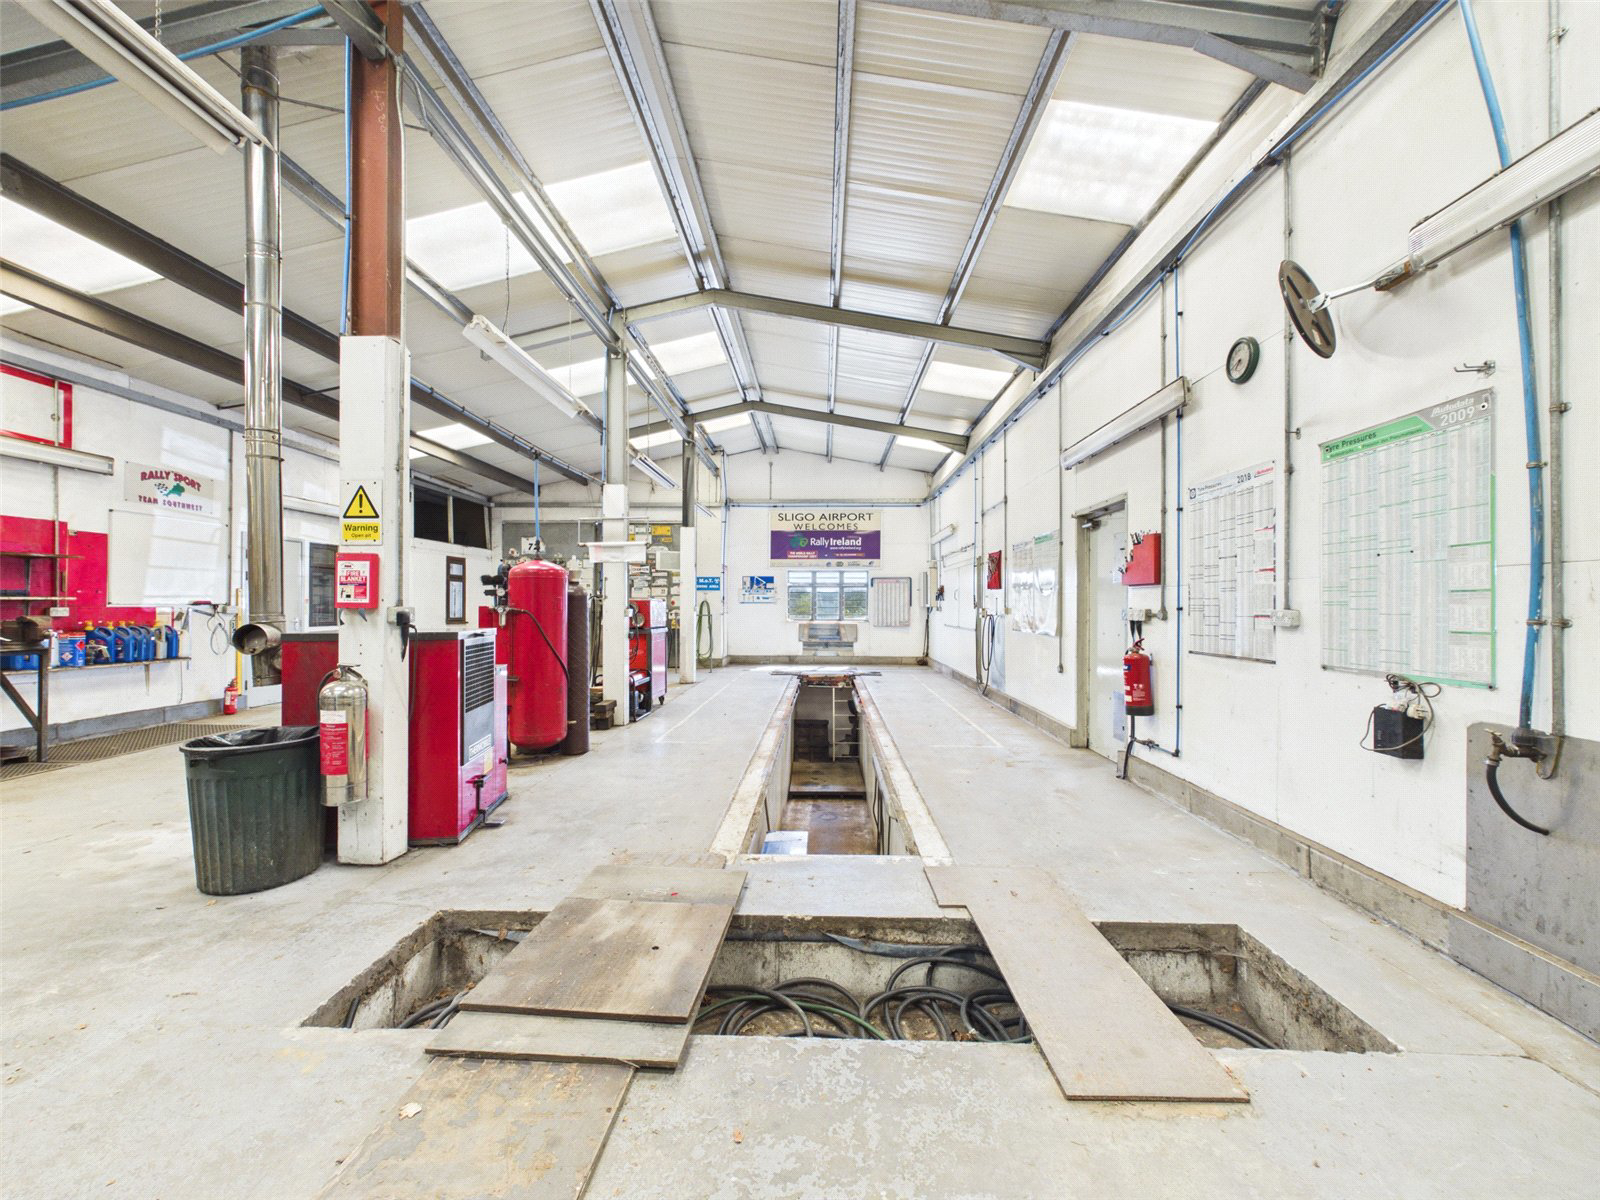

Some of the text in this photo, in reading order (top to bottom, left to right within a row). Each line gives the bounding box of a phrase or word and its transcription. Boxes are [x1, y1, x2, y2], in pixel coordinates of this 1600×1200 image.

[1431, 397, 1474, 417] Autodata
[1440, 406, 1475, 427] 2009
[1341, 432, 1377, 448] Pressures
[140, 470, 201, 492] RALLY SPORT
[1236, 472, 1252, 484] 2018
[138, 494, 203, 511] TEAM SOUTHWEST
[777, 513, 874, 521] SLIGO AIRPORT
[344, 524, 379, 533] Warning
[793, 523, 859, 531] WELCOMES
[810, 537, 862, 548] Rally Ireland
